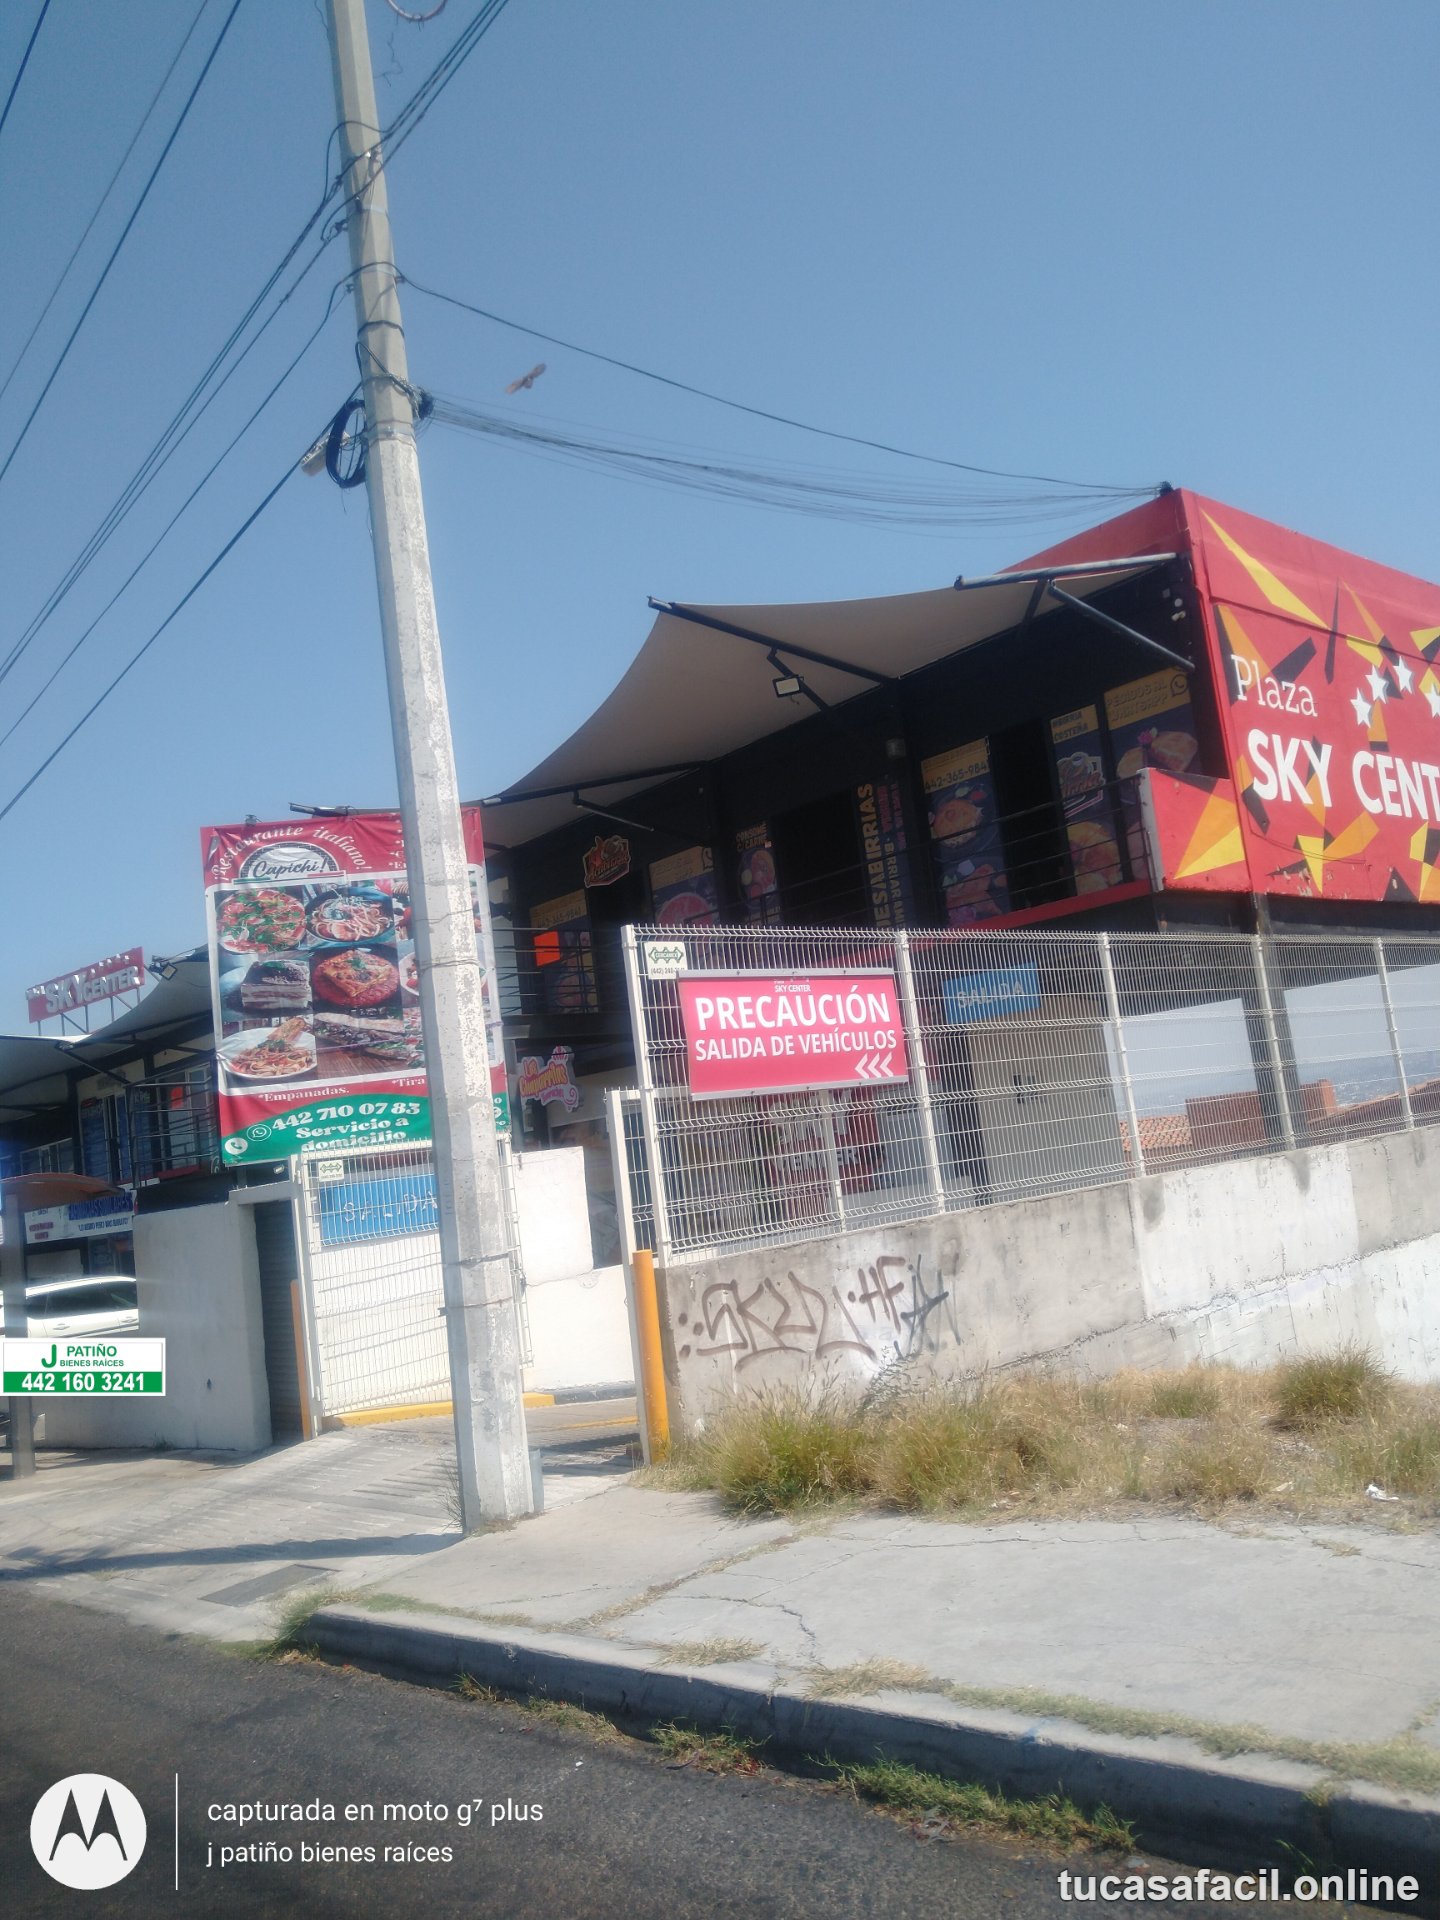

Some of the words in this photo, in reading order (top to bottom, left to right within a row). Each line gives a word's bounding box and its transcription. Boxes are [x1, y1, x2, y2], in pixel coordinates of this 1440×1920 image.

[1231, 654, 1318, 717] Plaza
[1248, 728, 1332, 808] SKY
[1352, 750, 1440, 822] CENT
[253, 860, 328, 880] Capichi!
[46, 974, 87, 1013] SKY
[84, 966, 141, 1001] CENTER
[774, 984, 788, 993] SKY
[788, 984, 811, 992] CENTER
[695, 985, 890, 1031] PRECAUCIÓN
[695, 1036, 767, 1061] SALIDA
[771, 1034, 795, 1056] DE
[798, 1027, 897, 1054] VEHÍCULOS
[392, 1077, 426, 1087] Tira
[272, 1111, 313, 1130] 442
[317, 1105, 354, 1121] 710
[359, 1103, 389, 1115] 07
[390, 1102, 421, 1115] 83
[296, 1118, 391, 1139] Servicio
[395, 1117, 410, 1127] a
[301, 1130, 406, 1152] domicilio
